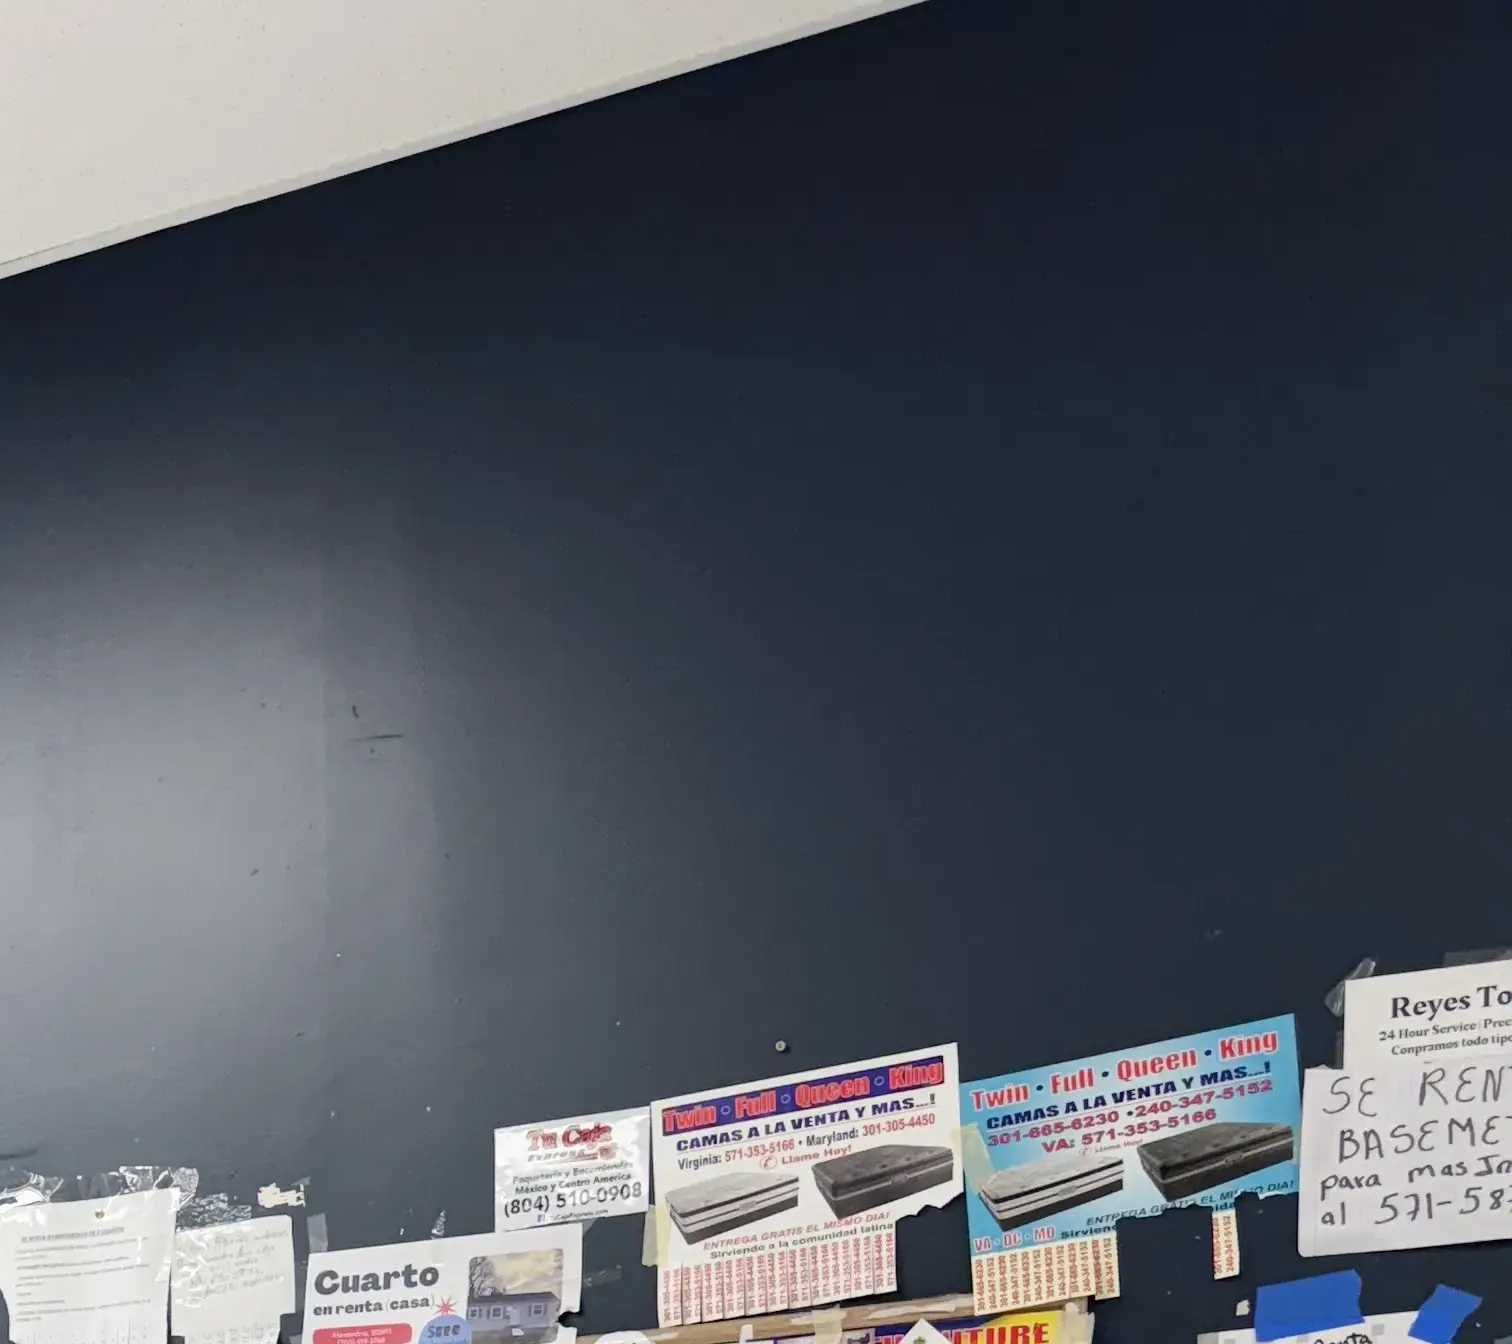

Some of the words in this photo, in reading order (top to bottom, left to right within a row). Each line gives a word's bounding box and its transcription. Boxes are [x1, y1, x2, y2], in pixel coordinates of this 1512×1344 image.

[1391, 995, 1470, 1020] Reyes
[1379, 1031, 1396, 1040] 24
[1399, 1028, 1428, 1039] Hour
[1432, 1022, 1476, 1035] Service
[1391, 1041, 1458, 1055] Conpramos
[1462, 1036, 1488, 1046] todo
[971, 1083, 1028, 1111] Twin
[1050, 1068, 1094, 1096] Full
[1117, 1049, 1197, 1081] Queen
[1220, 1031, 1278, 1060] King
[662, 1106, 716, 1132] Twin
[735, 1091, 776, 1118] Full
[795, 1076, 870, 1108] Queen
[889, 1061, 944, 1090] King
[987, 1105, 1059, 1130] CAMAS
[1084, 1095, 1107, 1110] LA
[1113, 1081, 1177, 1104] VENTA
[1323, 1076, 1377, 1117] SE
[1419, 1066, 1512, 1106] REN
[677, 1130, 743, 1151] CAMAS
[765, 1121, 786, 1134] LA
[791, 1110, 850, 1130] VENTA
[678, 1154, 722, 1170] Virginia:
[724, 1140, 794, 1162] 571-353-5166
[806, 1129, 859, 1147] Maryland:
[862, 1113, 935, 1136] 301-305-4450
[1042, 1139, 1075, 1152] VA:
[1082, 1108, 1216, 1146] 571-353-5166
[1339, 1115, 1512, 1162] BASEME
[559, 1179, 590, 1189] Centro
[1320, 1173, 1381, 1201] para
[1408, 1160, 1467, 1183] mas
[504, 1195, 550, 1217] (804)
[556, 1182, 642, 1208] 510-0908
[1375, 1186, 1512, 1224] 571-58
[704, 1234, 757, 1250] ENTREGA
[761, 1226, 803, 1241] GRATIS
[824, 1216, 863, 1230] MISMO
[710, 1243, 764, 1259] Sirviendo
[792, 1227, 857, 1246] comunidad
[861, 1222, 893, 1235] latina
[1034, 1227, 1054, 1241] MD
[315, 1263, 439, 1296] Cuarto
[313, 1304, 332, 1316] en
[335, 1300, 383, 1314] renta
[385, 1294, 435, 1312] (casa)
